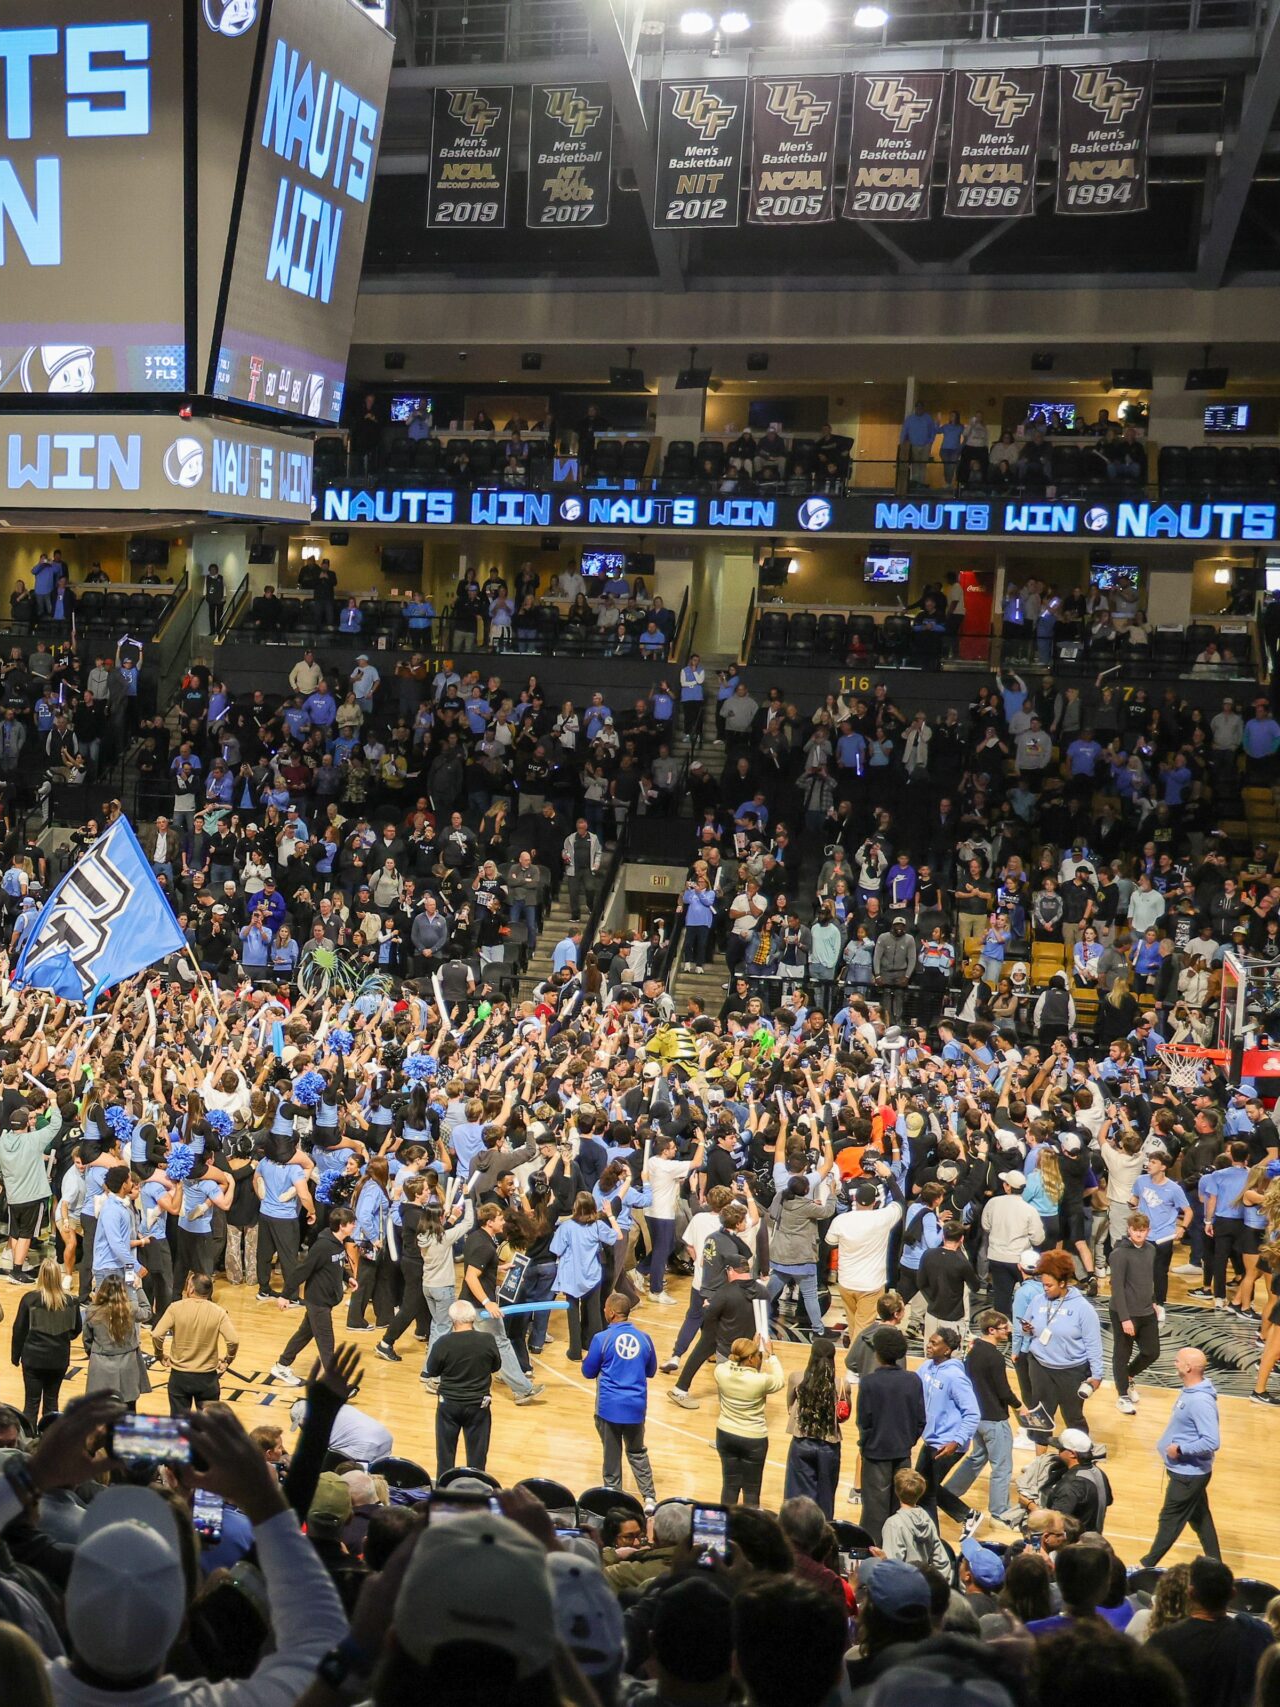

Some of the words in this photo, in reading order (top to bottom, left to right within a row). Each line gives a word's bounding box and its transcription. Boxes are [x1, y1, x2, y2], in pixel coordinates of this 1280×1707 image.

[864, 77, 933, 133] UCF
[966, 72, 1034, 128] UCF
[1070, 68, 1144, 124] UCF
[446, 88, 501, 136] UCF
[543, 88, 603, 137] UCF
[669, 85, 737, 140] UCF
[764, 81, 831, 136] UCF
[260, 38, 379, 203] NAUTS
[454, 137, 487, 147] Men's
[876, 138, 911, 149] Men's
[978, 133, 1014, 145] Men's
[1087, 129, 1125, 141] Men's
[440, 147, 500, 159] Basketball
[553, 140, 586, 152] Men's
[684, 145, 718, 157] Men's
[779, 141, 813, 152] Men's
[859, 148, 926, 161] Basketball
[961, 145, 1029, 157] Basketball
[1069, 139, 1140, 155] Basketball
[537, 152, 601, 164] Basketball
[669, 156, 732, 169] Basketball
[762, 152, 827, 164] Basketball
[557, 166, 585, 180] NIT
[676, 173, 723, 195] NIT
[852, 191, 921, 212] 2004
[957, 186, 1020, 208] 1996
[1066, 183, 1132, 206] 1994
[434, 202, 498, 222] 2019
[540, 205, 594, 223] 2017
[665, 199, 727, 220] 2012
[756, 195, 823, 216] 2005
[265, 177, 344, 304] WIN
[145, 357, 152, 367] 3
[154, 357, 177, 367] TOL
[145, 370, 152, 380] 7
[155, 370, 178, 380] FLS
[266, 373, 276, 396] 80
[7, 432, 141, 490] WIN
[211, 438, 273, 499] NAUTS
[279, 450, 312, 506] WIN
[324, 489, 453, 523] NAUTS
[471, 493, 550, 526] WIN
[589, 498, 695, 525] NAUTS
[709, 501, 775, 526] WIN
[875, 503, 989, 530] NAUTS
[1005, 505, 1076, 532] WIN
[1117, 503, 1276, 539] NAUTS
[423, 659, 440, 673] 11
[839, 676, 870, 692] 116
[652, 875, 667, 886] EXIT
